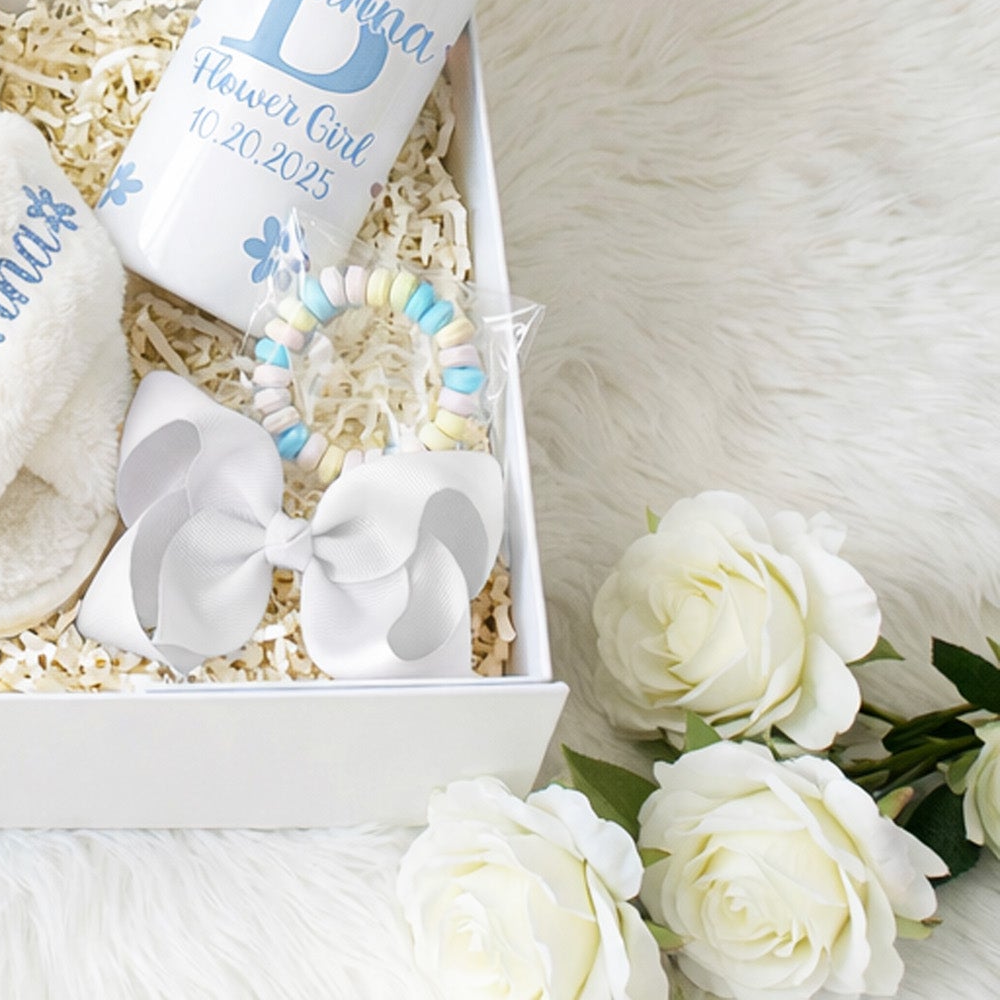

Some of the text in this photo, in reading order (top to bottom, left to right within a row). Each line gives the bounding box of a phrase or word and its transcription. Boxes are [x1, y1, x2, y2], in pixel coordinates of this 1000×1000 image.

[191, 107, 334, 199] 10.20.2025
[193, 48, 376, 168] Flower Girl
